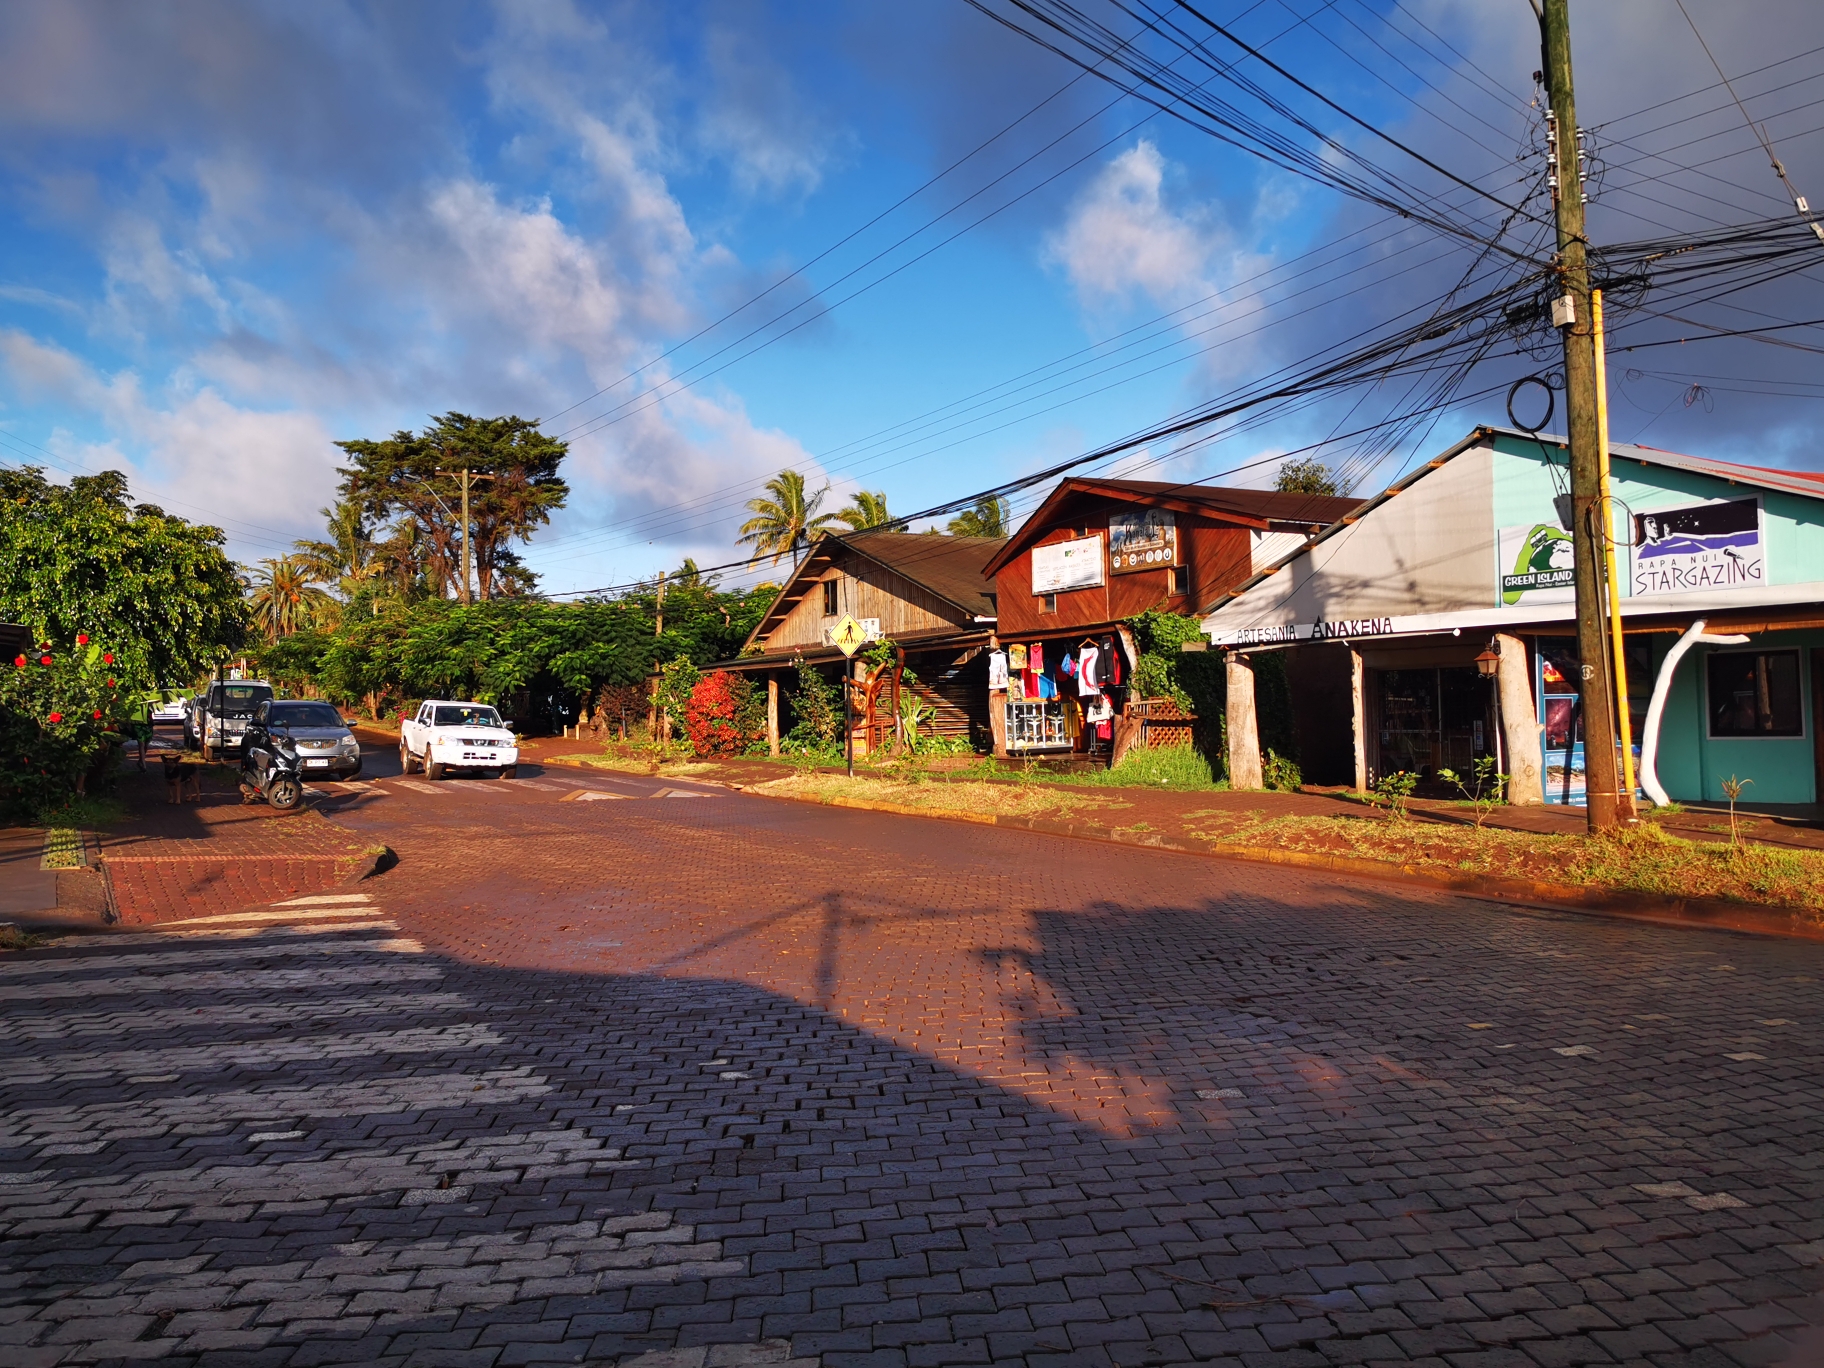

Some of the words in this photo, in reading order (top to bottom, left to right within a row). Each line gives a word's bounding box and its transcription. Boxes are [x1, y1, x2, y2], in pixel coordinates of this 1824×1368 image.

[1638, 559, 1677, 570] RAPA
[1690, 553, 1717, 564] NUI
[1505, 575, 1535, 587] GREEN
[1537, 570, 1573, 583] ISLAND
[1635, 557, 1761, 595] STARGAZING
[1237, 625, 1297, 644] ARTESANIA
[1311, 615, 1393, 639] ANAKENA
